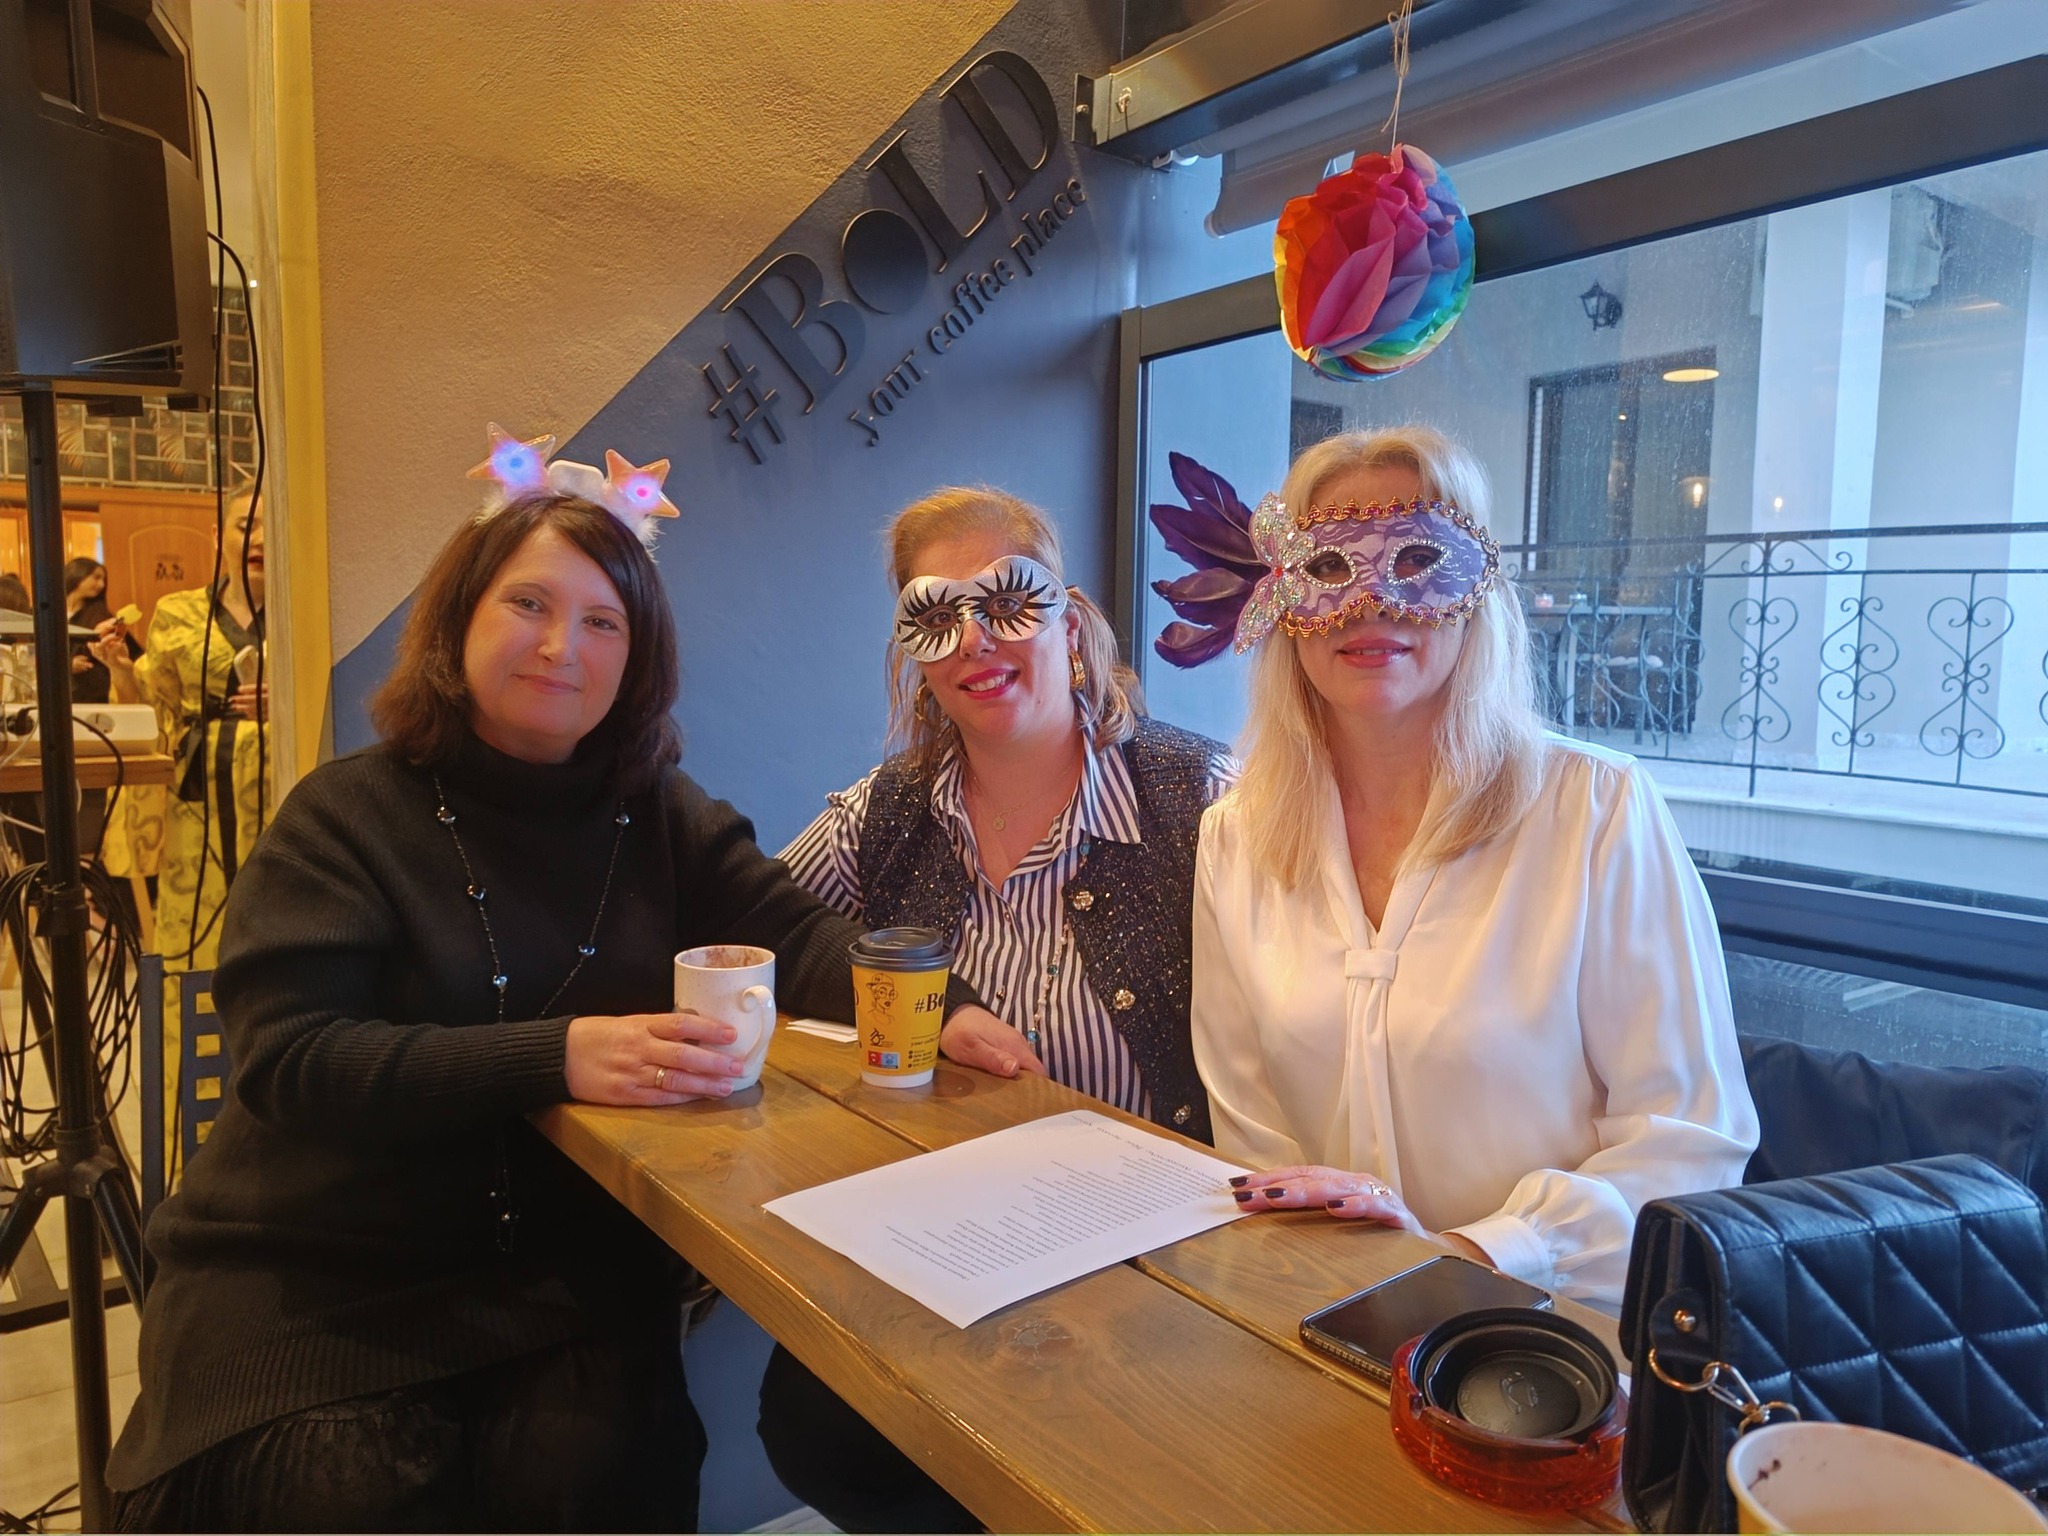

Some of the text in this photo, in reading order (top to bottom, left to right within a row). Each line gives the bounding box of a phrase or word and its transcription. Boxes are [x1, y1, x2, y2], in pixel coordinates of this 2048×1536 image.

[849, 177, 1088, 448] your coffee place
